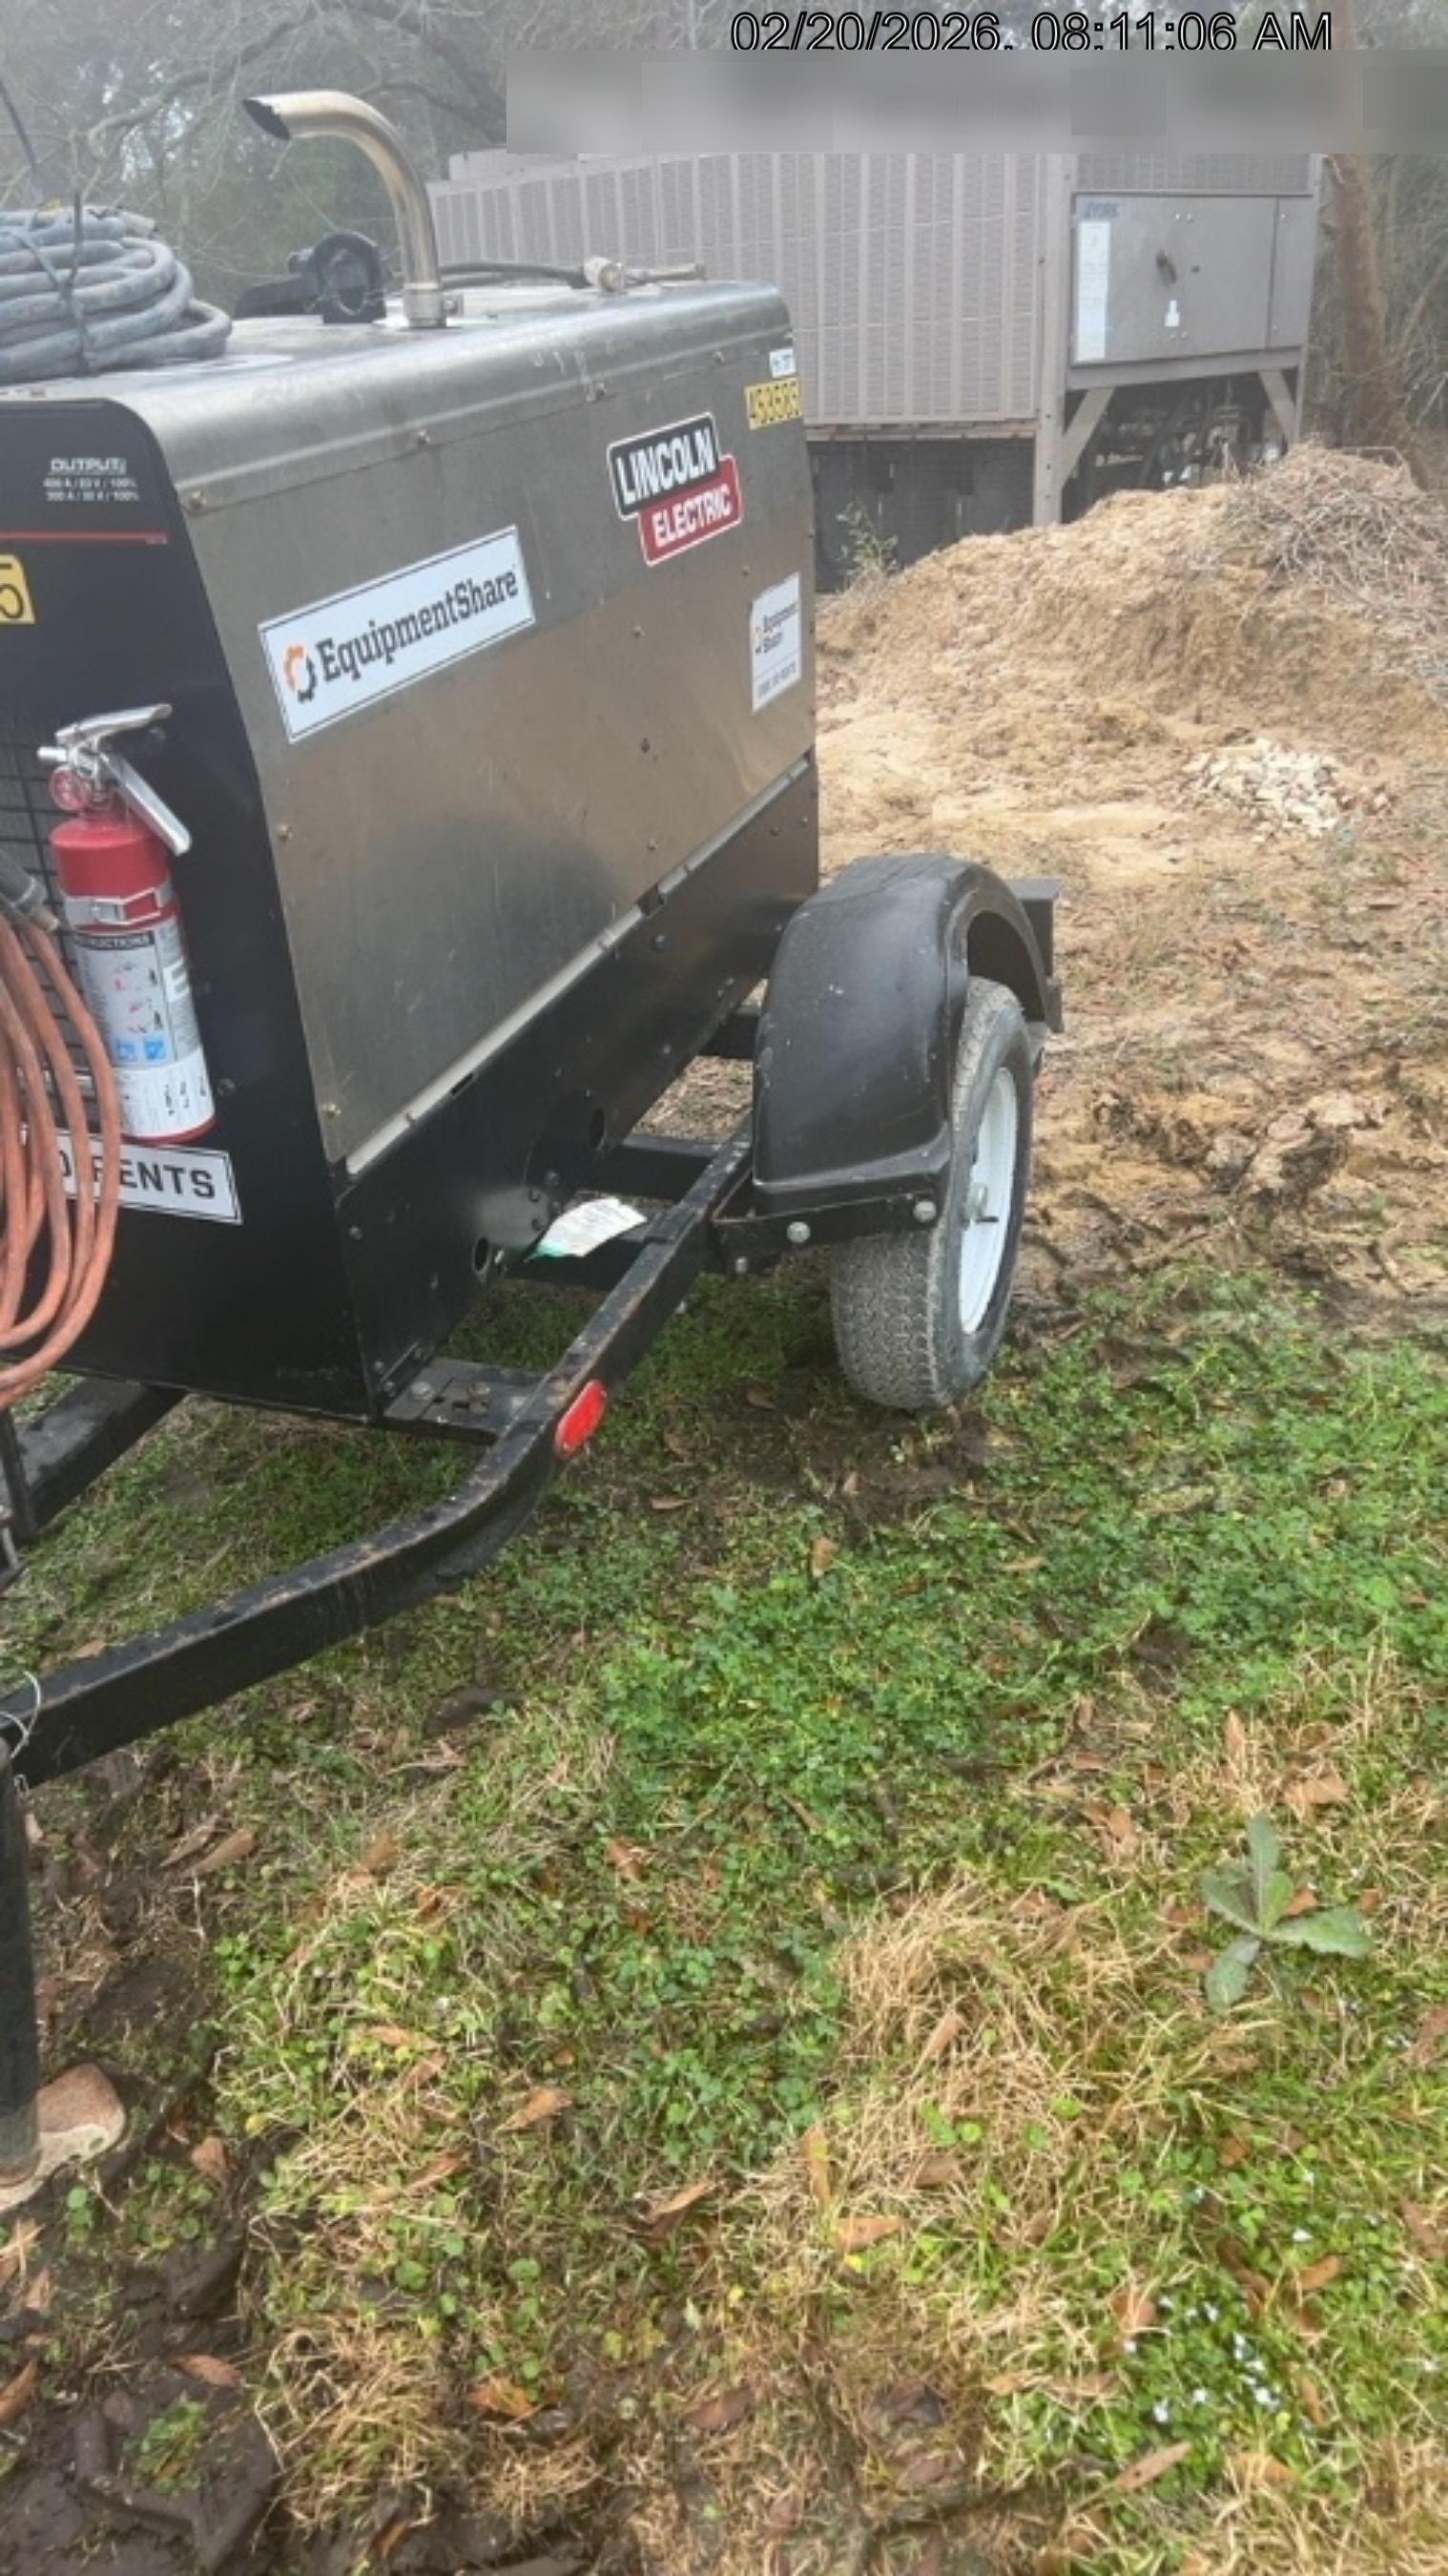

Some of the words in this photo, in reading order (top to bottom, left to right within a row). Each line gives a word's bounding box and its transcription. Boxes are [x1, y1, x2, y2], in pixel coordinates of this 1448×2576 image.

[616, 427, 715, 505] LINCOLN
[652, 483, 733, 548] ELECTRIC
[315, 570, 518, 682] EquipmentShare
